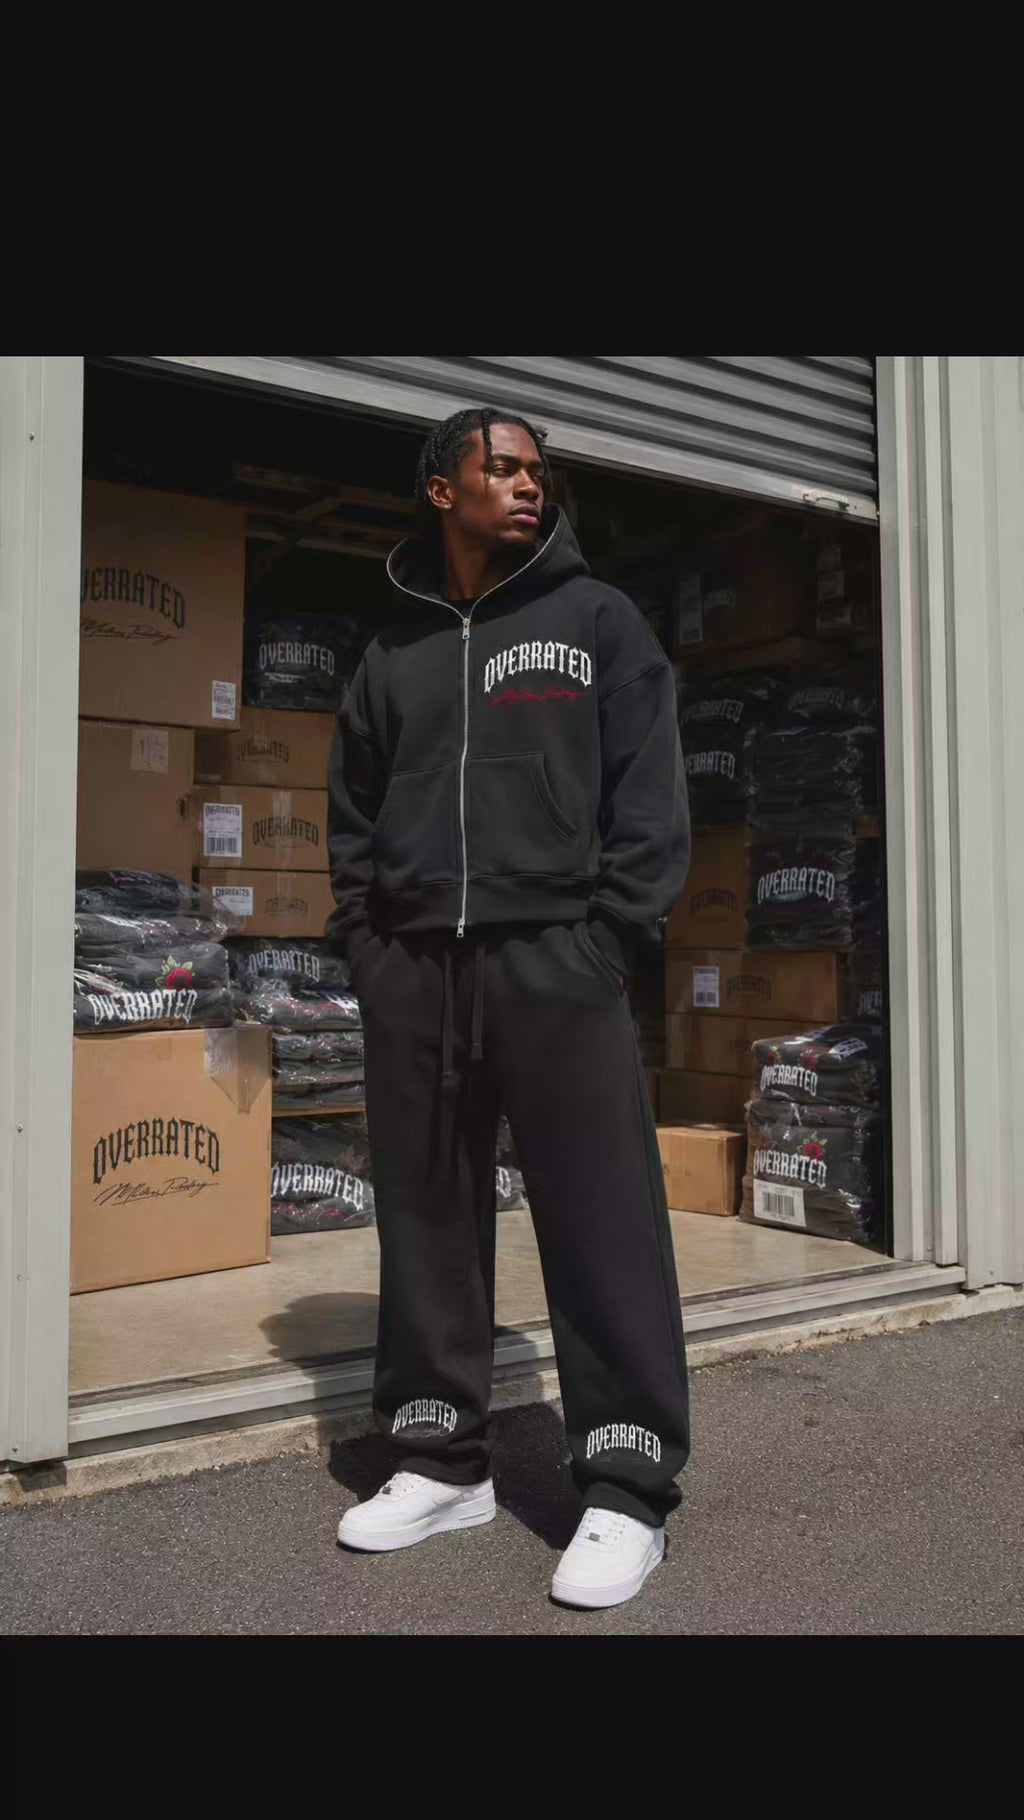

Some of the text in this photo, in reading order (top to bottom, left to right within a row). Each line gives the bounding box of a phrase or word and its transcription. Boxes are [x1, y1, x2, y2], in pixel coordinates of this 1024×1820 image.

[81, 566, 186, 629] ERRATED
[259, 642, 335, 676] OVERRATED
[484, 640, 592, 693] OVERRATED
[685, 751, 736, 781] ERRATED
[252, 816, 319, 847] OVERRATED
[757, 867, 836, 904] OVERRATED
[86, 989, 198, 1025] OVERRATED
[760, 1064, 818, 1097] OVERRATED
[93, 1117, 220, 1184] OVERRATED
[753, 1149, 827, 1189] OVERRATED
[391, 1398, 458, 1435] OVERRATED
[585, 1423, 661, 1463] OVERRATED
